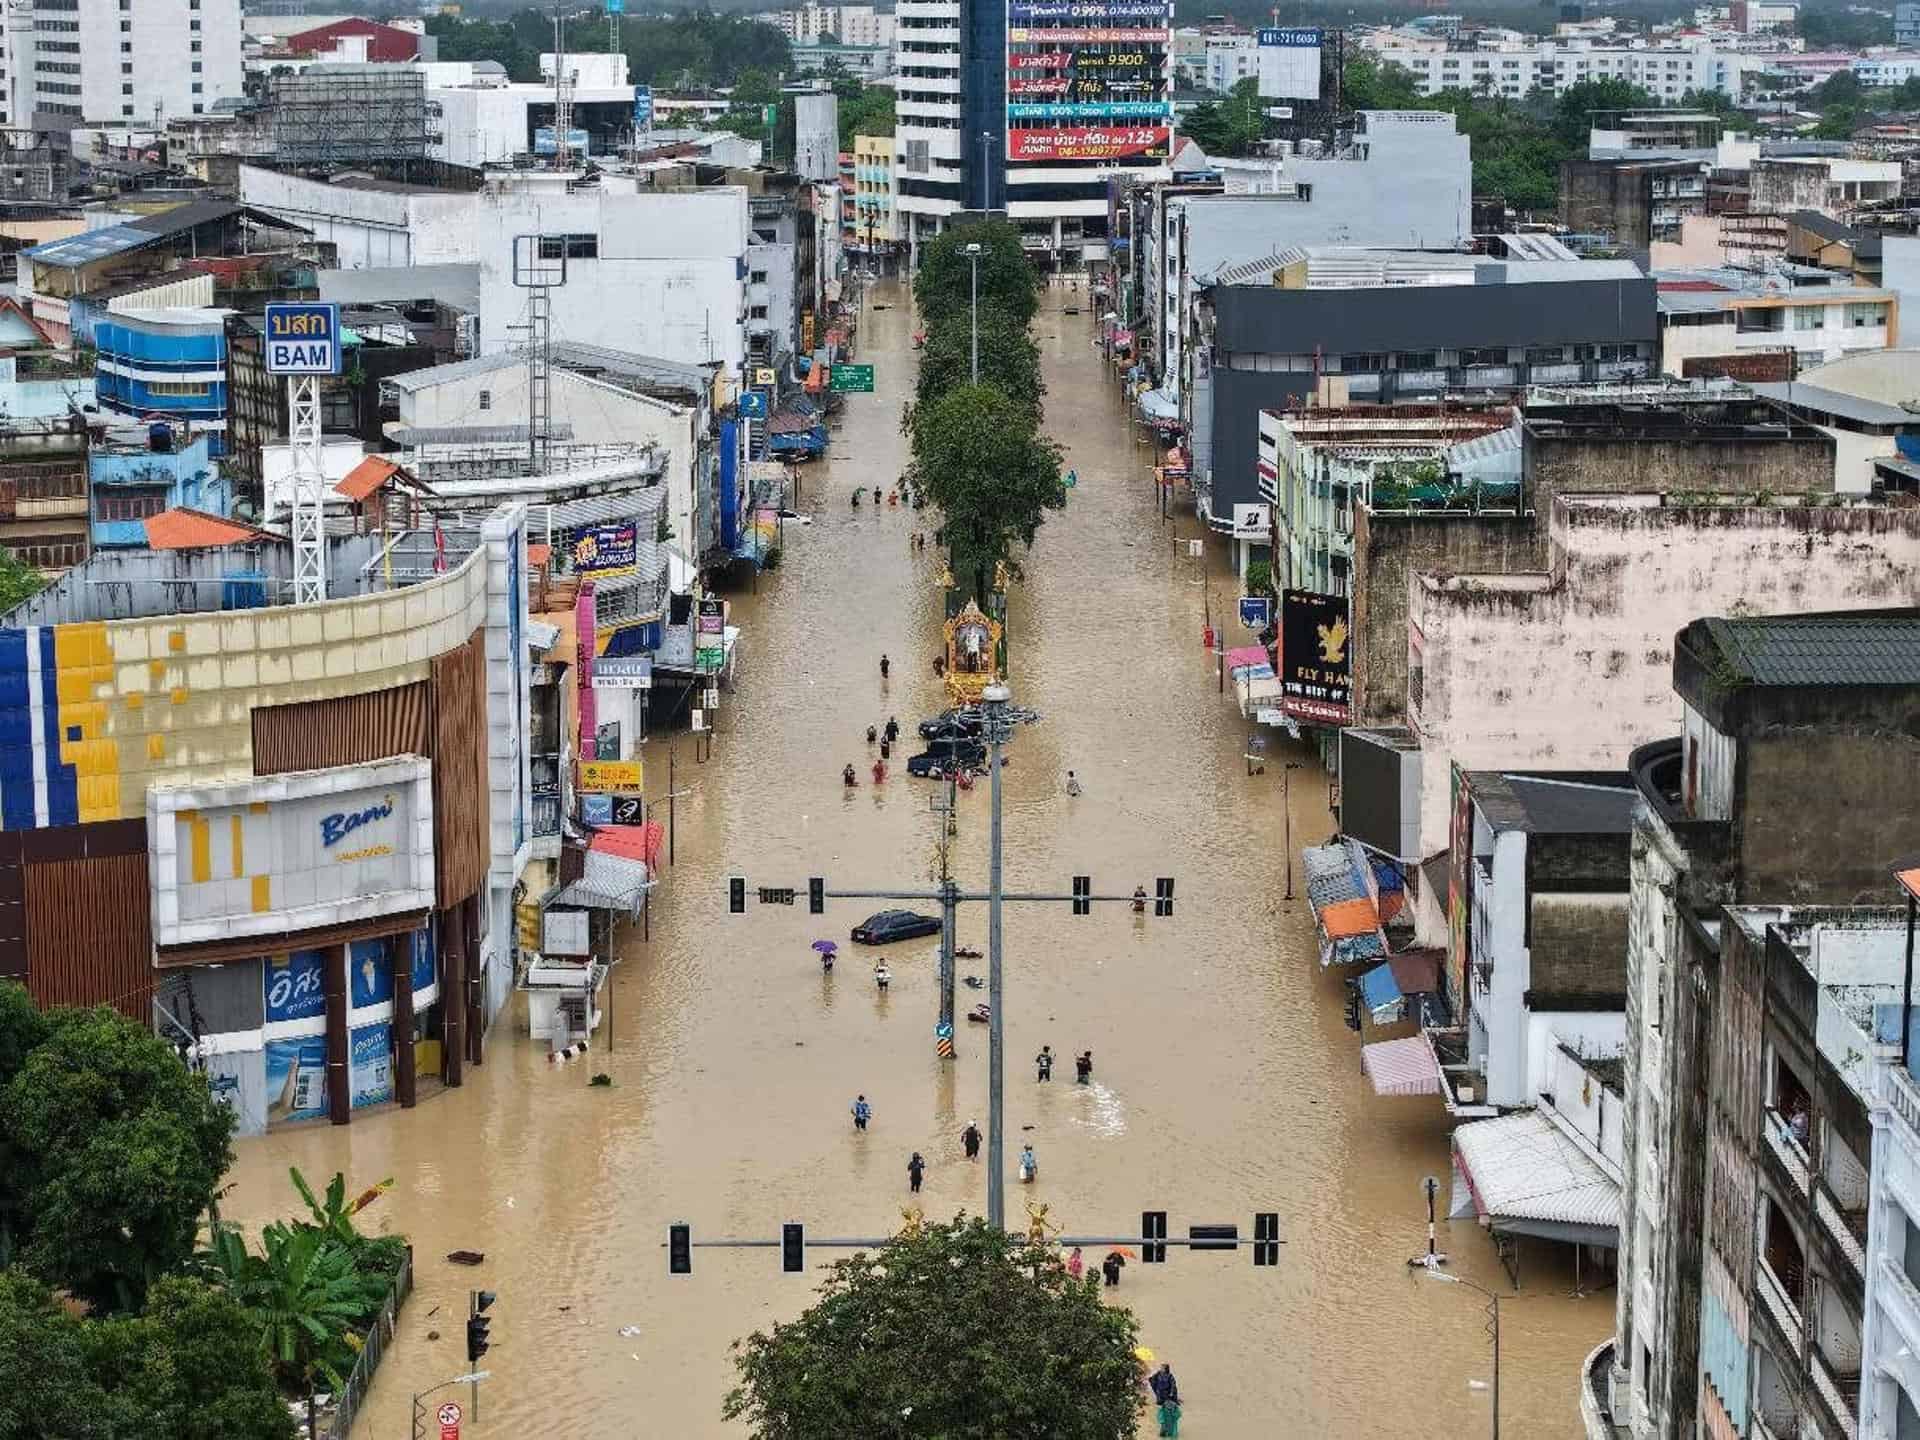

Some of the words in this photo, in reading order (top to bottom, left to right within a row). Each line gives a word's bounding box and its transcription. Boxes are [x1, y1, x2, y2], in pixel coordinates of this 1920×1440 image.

[272, 312, 327, 335] บสก
[275, 345, 327, 366] BAM
[1297, 666, 1319, 681] FLY
